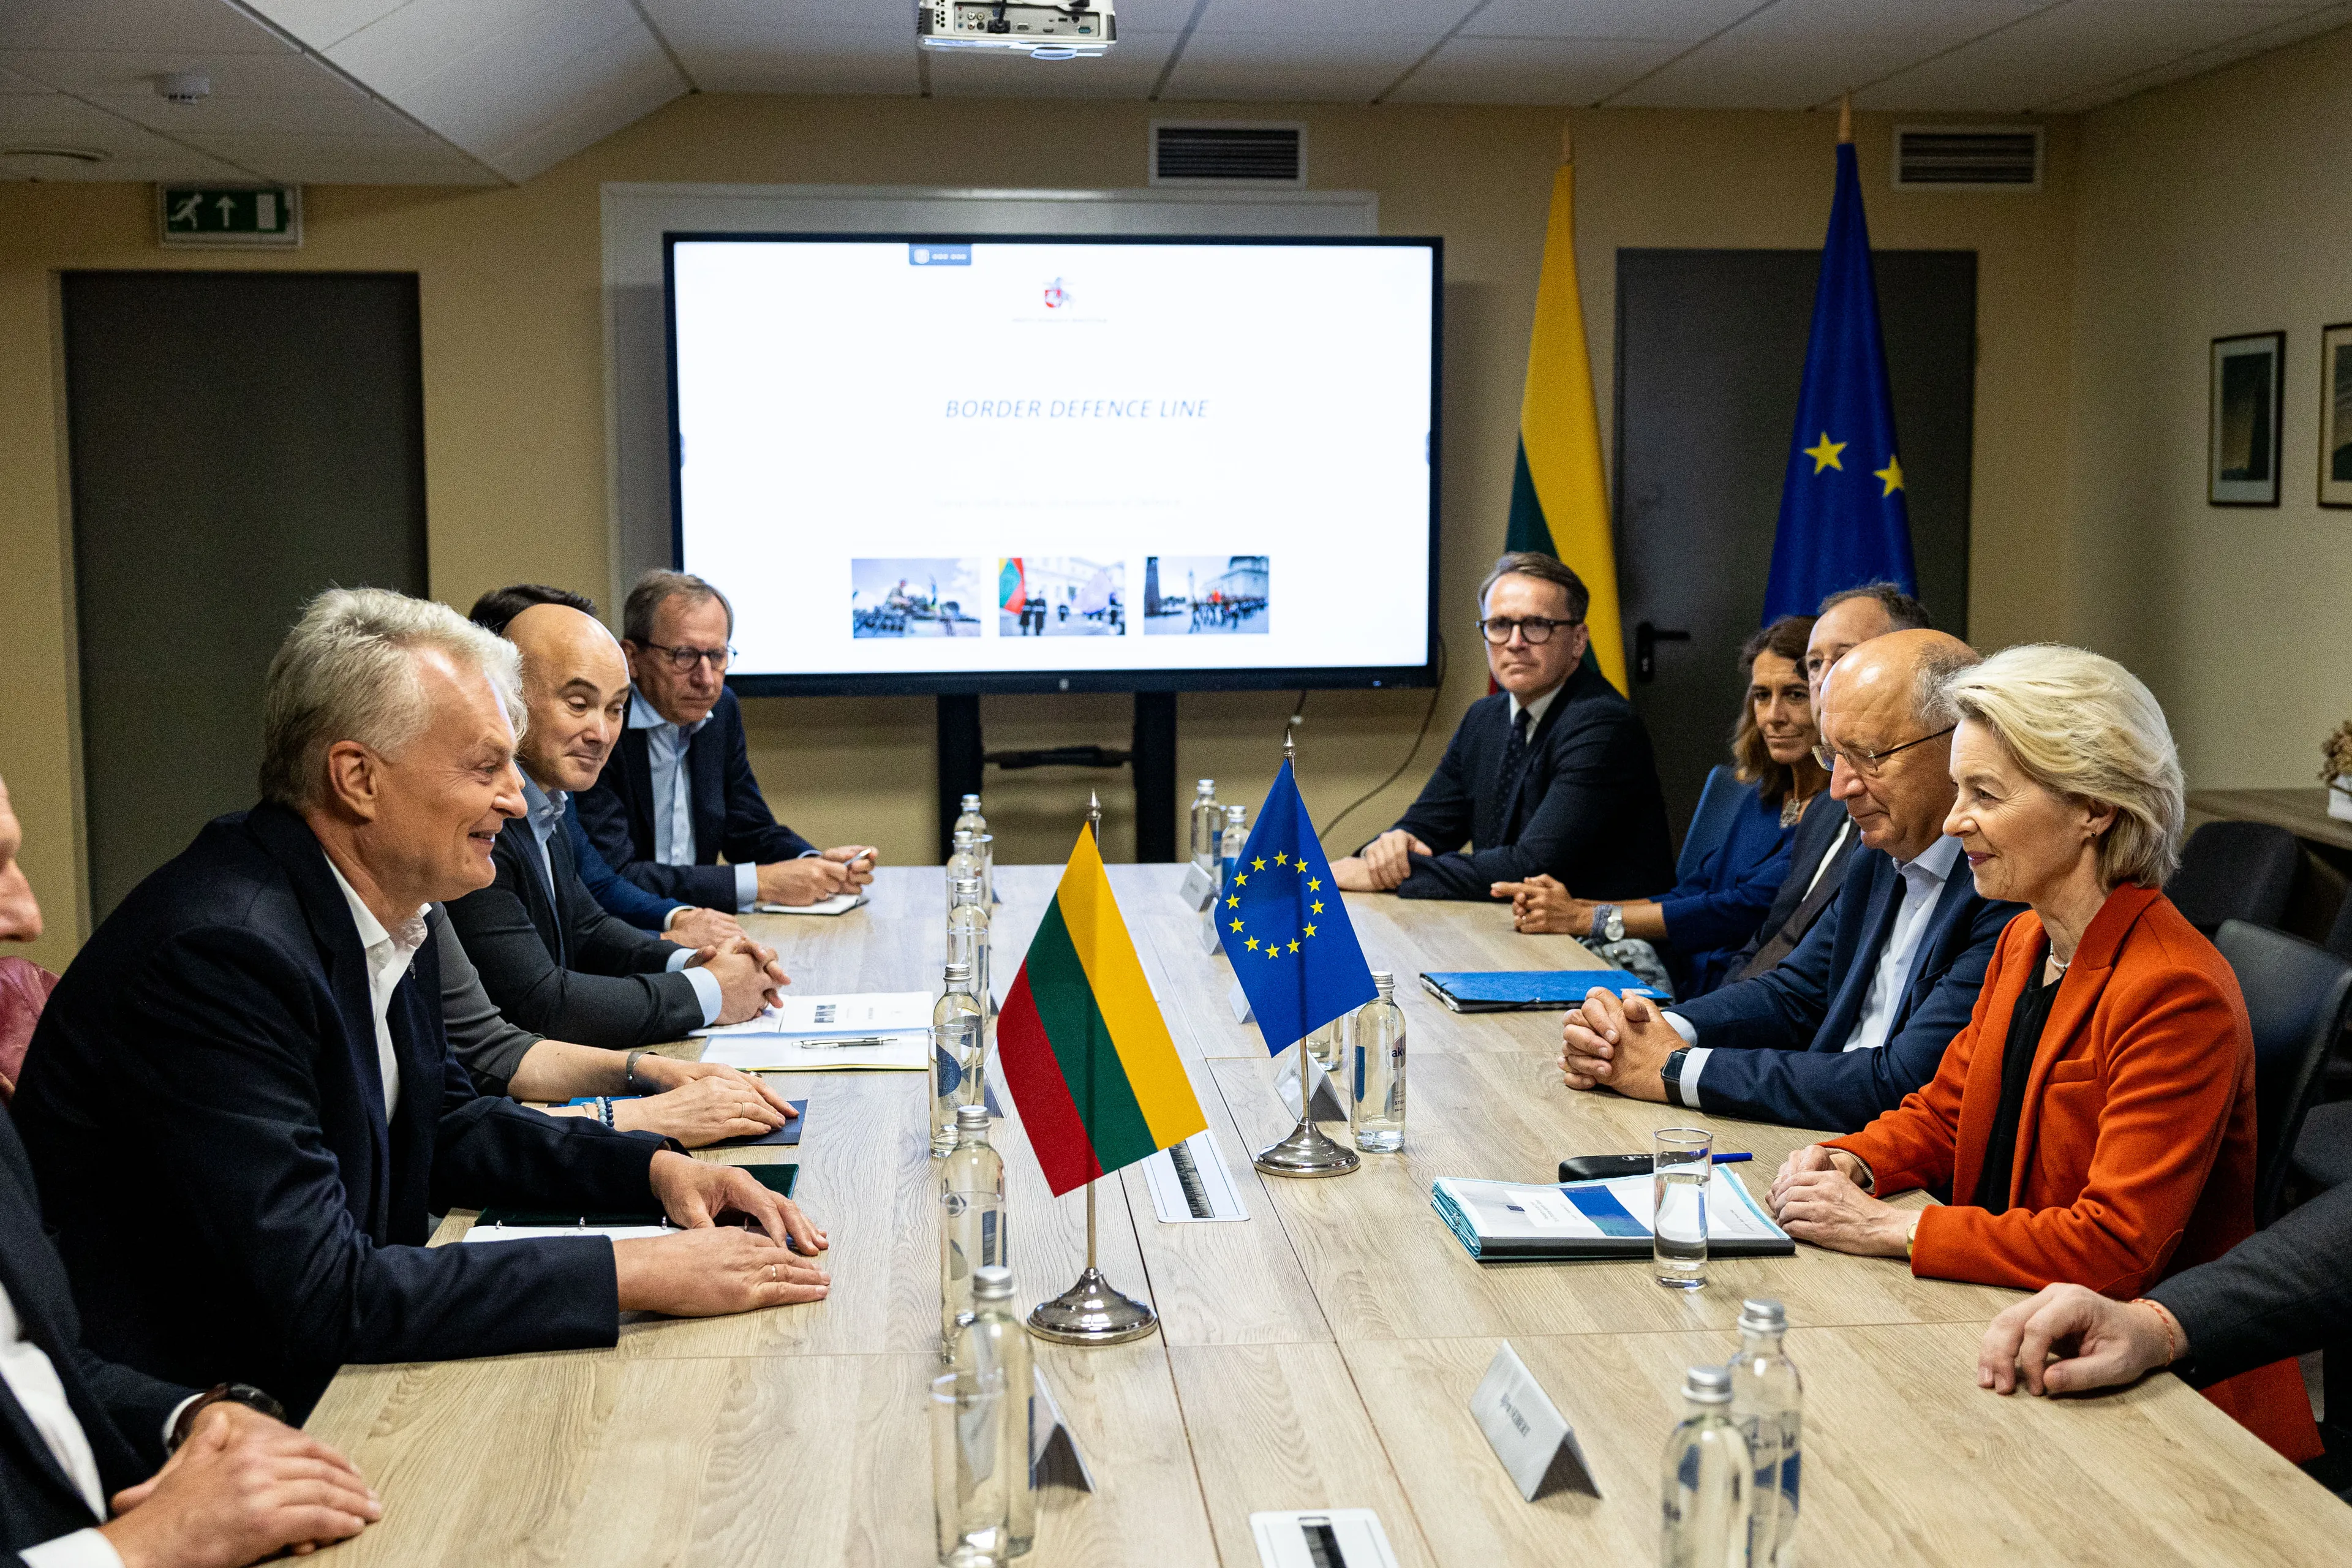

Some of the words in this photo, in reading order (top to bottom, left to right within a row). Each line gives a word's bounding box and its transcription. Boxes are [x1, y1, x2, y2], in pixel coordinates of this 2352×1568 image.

[946, 400, 1042, 418] BORDER
[1049, 399, 1153, 418] DEFENCE
[1159, 399, 1210, 418] LINE
